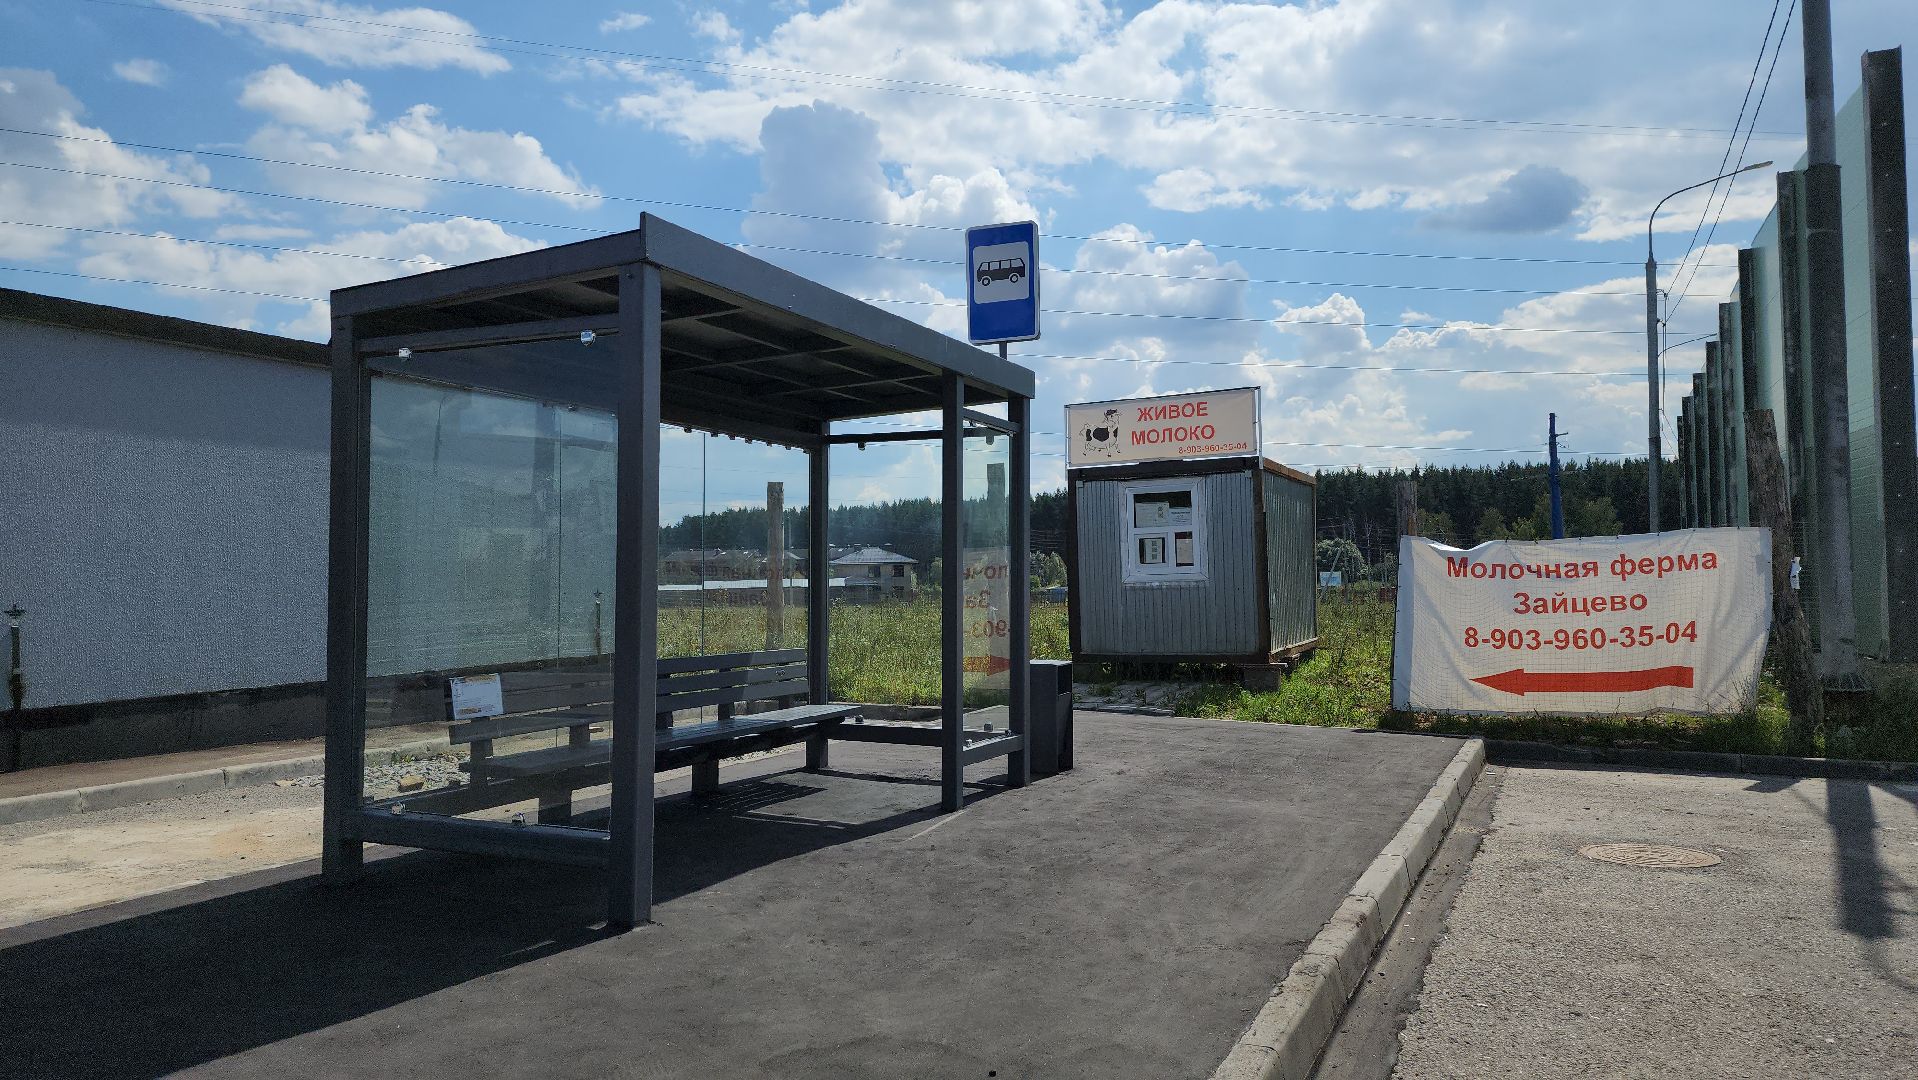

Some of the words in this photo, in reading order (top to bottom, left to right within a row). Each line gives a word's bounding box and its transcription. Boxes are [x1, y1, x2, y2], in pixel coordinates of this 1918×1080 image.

[1138, 402, 1208, 422] ЖИВОЕ
[1131, 425, 1216, 446] МОЛОКО
[1178, 442, 1248, 455] 8-903-960-35-04
[1447, 556, 1599, 580] Молочная
[1610, 551, 1719, 582] ферма
[1513, 592, 1648, 617] Зайцево
[1464, 620, 1698, 651] 8-903-960-35-04
